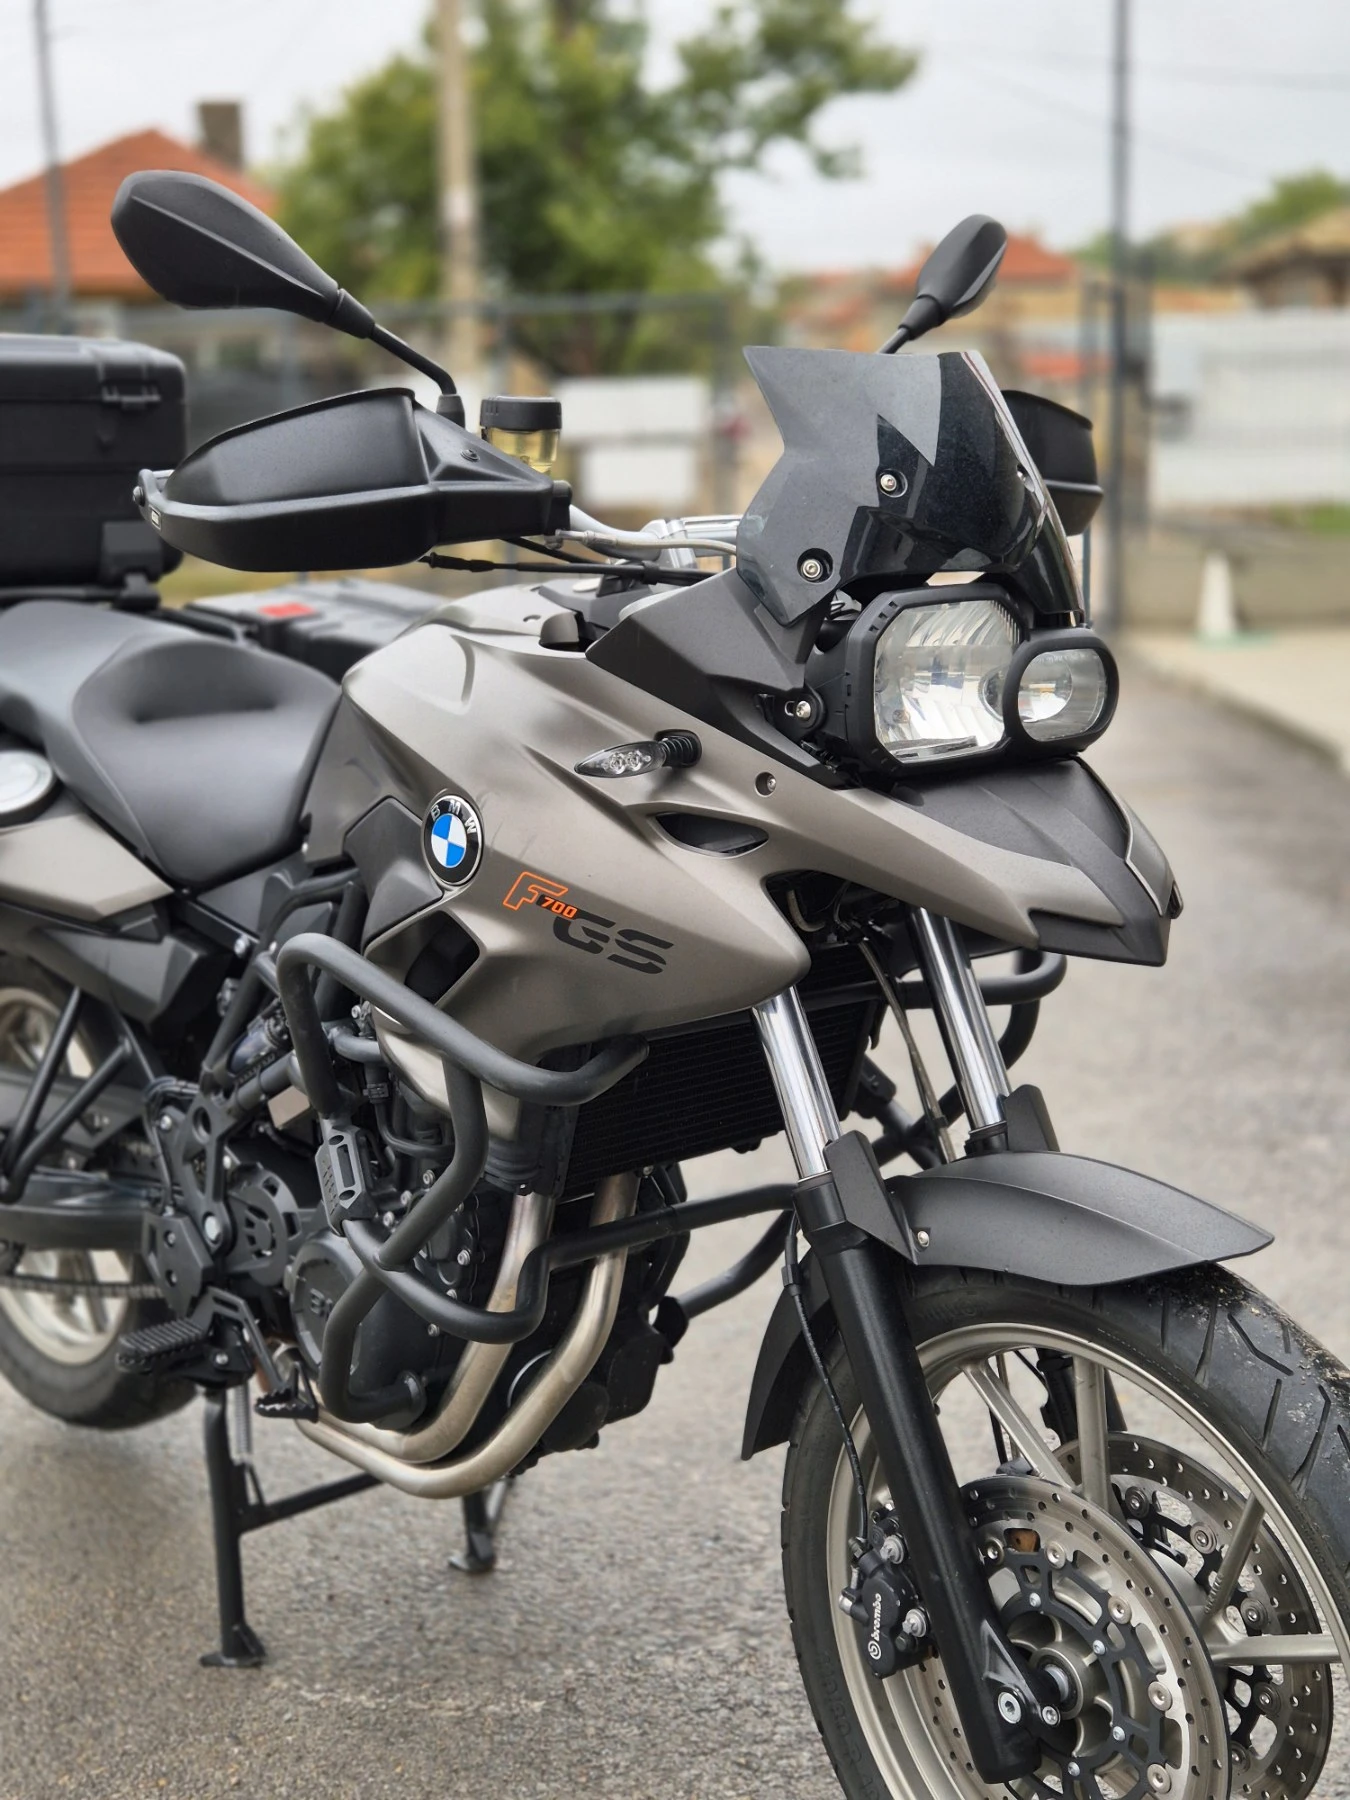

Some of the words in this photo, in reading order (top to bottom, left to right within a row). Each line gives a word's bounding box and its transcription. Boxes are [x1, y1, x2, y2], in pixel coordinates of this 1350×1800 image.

[430, 799, 478, 835] BMW
[503, 871, 569, 911] F
[540, 896, 577, 919] 700
[553, 908, 675, 975] GS
[871, 1593, 882, 1642] brembo
